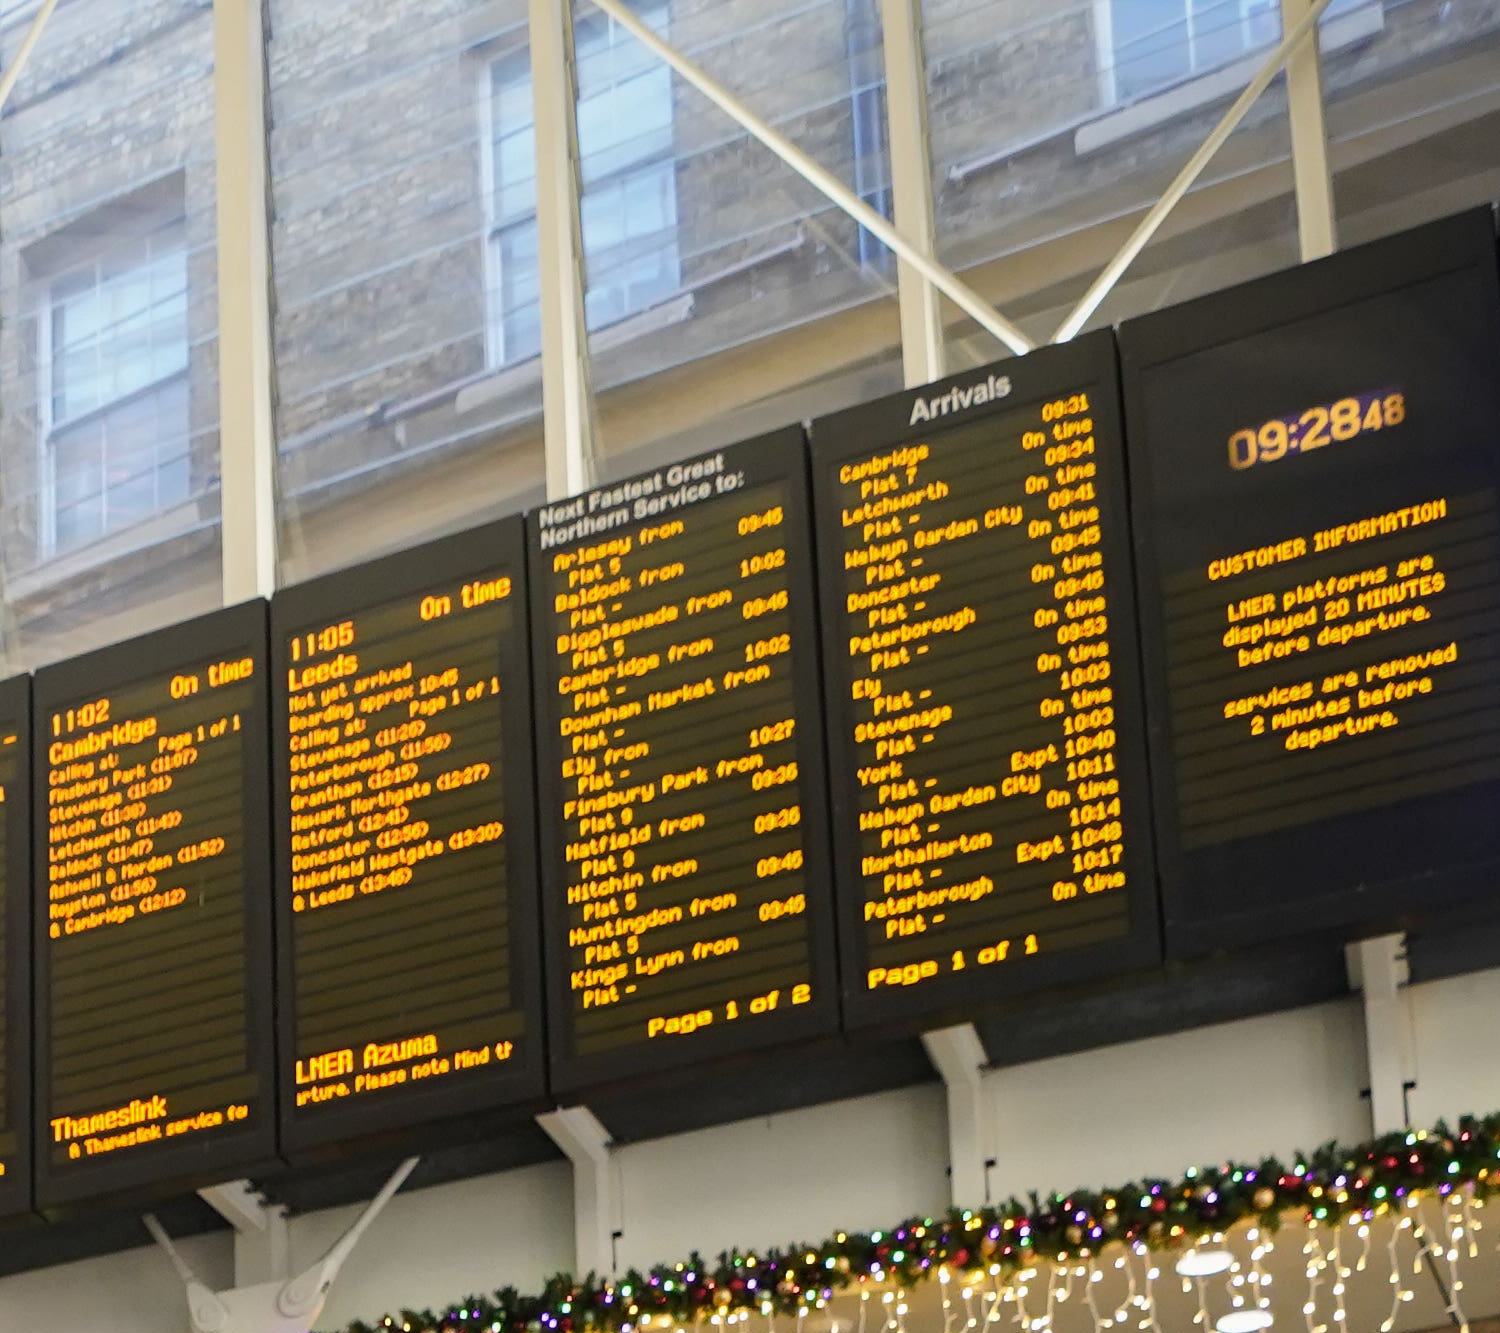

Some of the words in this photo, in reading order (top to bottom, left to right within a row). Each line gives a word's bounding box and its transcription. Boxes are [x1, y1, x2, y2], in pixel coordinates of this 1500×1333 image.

[910, 376, 1009, 422] Arrivals
[539, 498, 584, 529] Next
[588, 473, 663, 513] Fastest
[666, 453, 725, 487] Great
[540, 507, 630, 550] Northern
[634, 481, 712, 520] Service
[715, 470, 745, 494] to:
[984, 505, 1022, 528] City
[1208, 537, 1306, 580] CUSTOMER
[1313, 498, 1445, 551] INFORMATION
[555, 576, 630, 612] Baldock
[847, 574, 940, 612] Doncaster
[1222, 606, 1316, 647] displayed
[1324, 597, 1349, 620] 20
[1356, 572, 1444, 613] MINUTES
[1227, 593, 1275, 622] LNER
[1282, 566, 1387, 610] platforms
[1396, 555, 1433, 577] are
[291, 621, 354, 661] 11:05
[420, 595, 450, 620] On
[460, 577, 510, 608] time
[849, 606, 975, 655] Peterborough
[1238, 635, 1309, 667] before
[1316, 605, 1430, 645] departure.
[288, 653, 358, 691] Leeds
[648, 677, 715, 711] Market
[852, 678, 881, 699] Ely
[1223, 682, 1312, 718] services
[1321, 671, 1358, 692] are
[1365, 642, 1456, 683] removed
[52, 698, 109, 736] 11:02
[170, 675, 198, 698] On
[207, 657, 253, 687] time
[1250, 715, 1264, 735] 2
[1271, 696, 1350, 729] minutes
[1357, 677, 1431, 708] before
[49, 717, 156, 765] Cambridge
[854, 705, 952, 742] Stevenage
[1285, 711, 1397, 750] departure.
[562, 756, 596, 777] Ely
[857, 760, 901, 785] York
[1001, 767, 1040, 796] City
[1066, 752, 1114, 781] 10:11
[564, 783, 654, 819] Finsbury
[661, 766, 707, 793] Park
[1069, 797, 1120, 826] 10:14
[565, 823, 650, 861] Hatfield
[567, 872, 643, 904] Hitchin
[864, 875, 993, 920] Peterborough
[1072, 844, 1122, 872] 10:17
[569, 906, 682, 946] Huntingdon
[571, 963, 627, 990] Kings
[635, 950, 684, 975] Lynn
[867, 960, 937, 988] Page
[952, 950, 964, 970] 1
[977, 940, 1009, 963] of
[1024, 934, 1037, 954] 1
[647, 1010, 712, 1037] Page
[726, 1000, 738, 1019] 1
[749, 990, 779, 1013] of
[791, 983, 810, 1004] 2
[295, 1048, 353, 1084] LNER
[363, 1034, 437, 1068] Azuma
[50, 1095, 166, 1144] Thameslink
